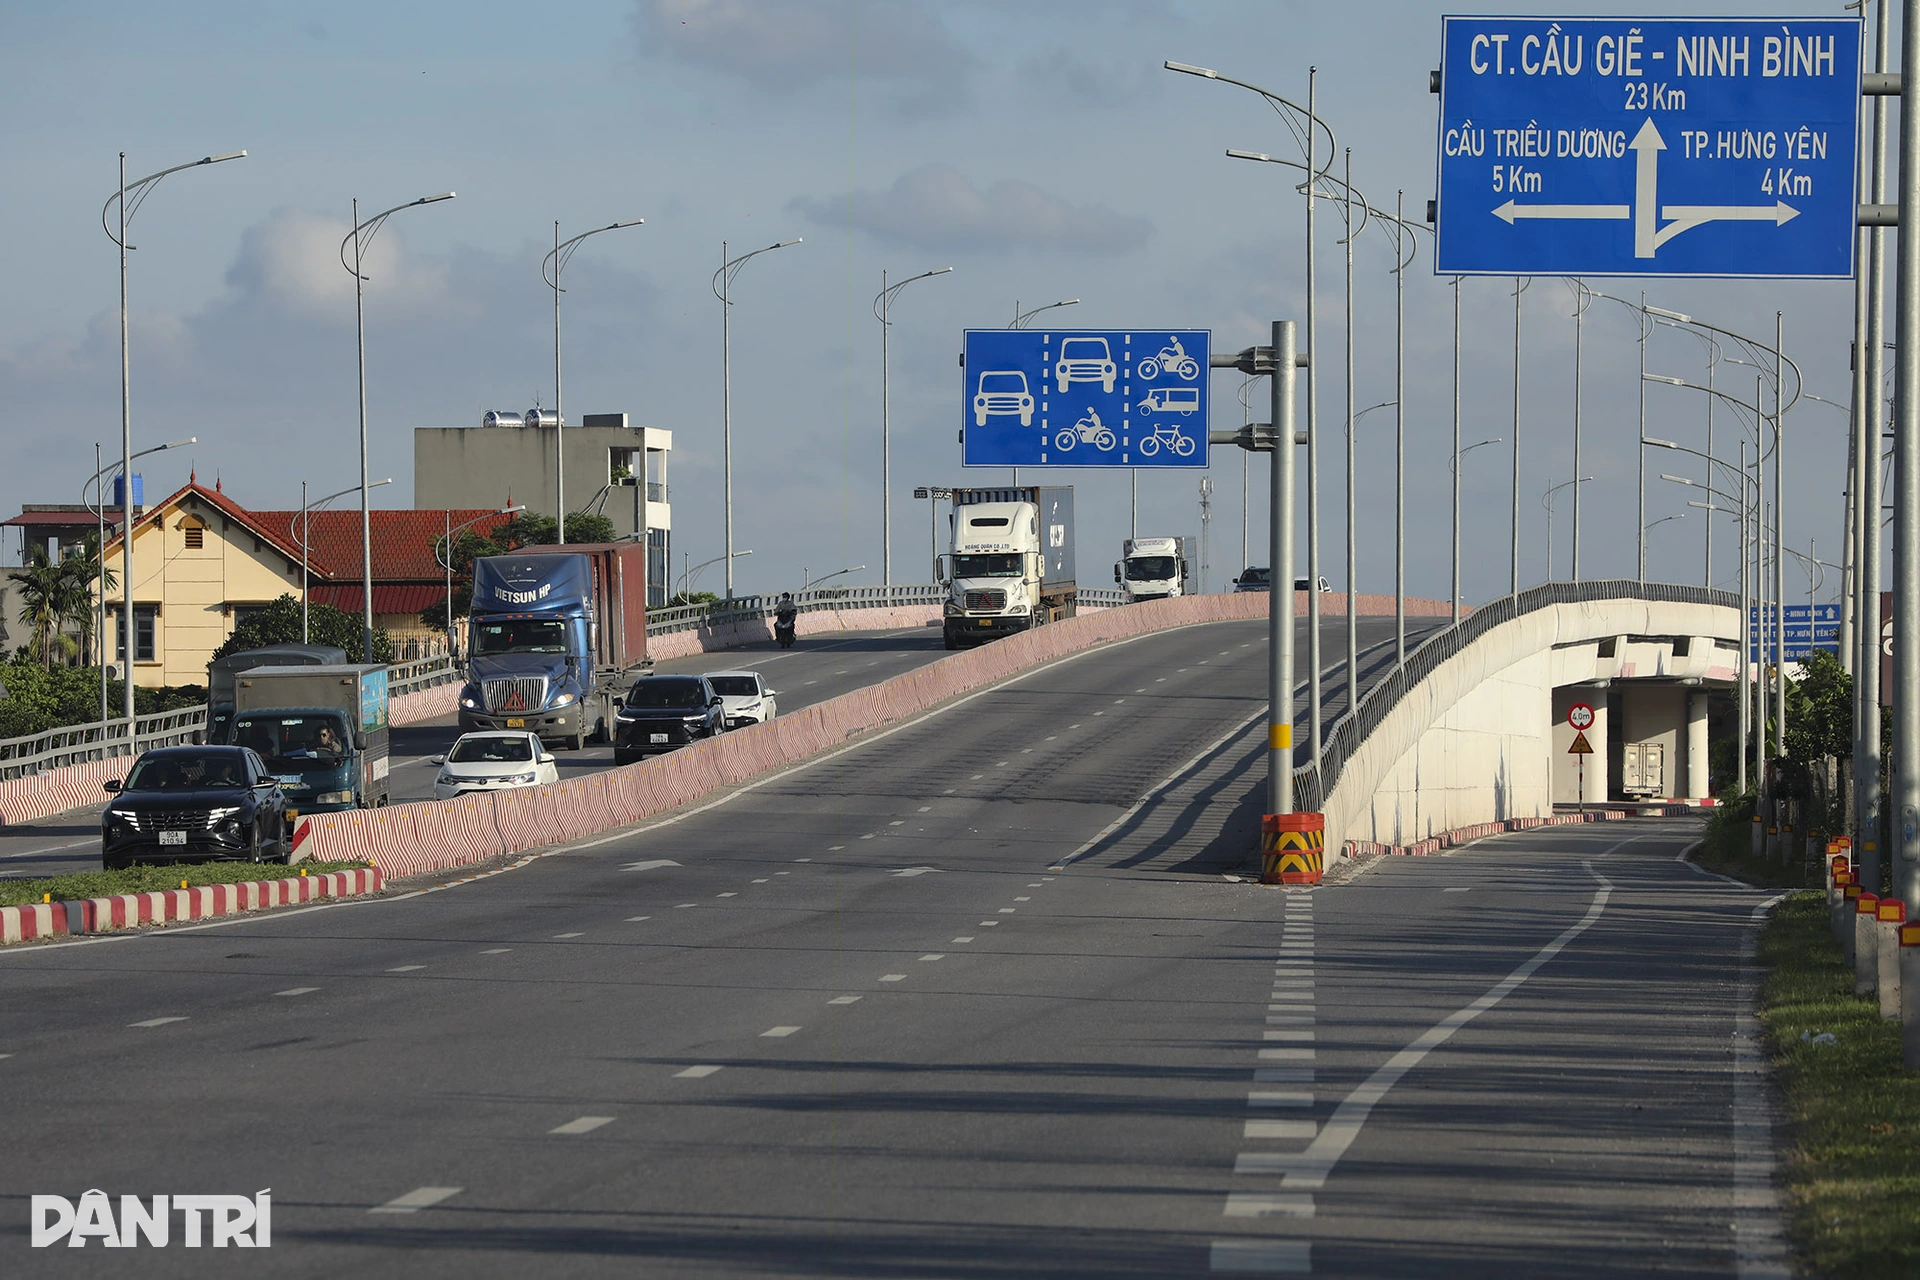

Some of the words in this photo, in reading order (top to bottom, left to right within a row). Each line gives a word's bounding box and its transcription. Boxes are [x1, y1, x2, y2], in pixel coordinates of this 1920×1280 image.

[1471, 23, 1583, 75] CT.CẦU
[1596, 28, 1643, 76] GIẼ
[1677, 36, 1749, 76] NINH
[1762, 26, 1834, 76] BÌNH
[1624, 83, 1648, 110] 23
[1653, 83, 1686, 110] Km
[1445, 120, 1484, 157] CẦU
[1493, 120, 1550, 157] TRIỀU
[1557, 129, 1626, 159] DƯƠNG
[1681, 129, 1776, 159] TP.HƯNG
[1784, 126, 1827, 159] YÊN
[1493, 166, 1504, 192] 5
[1509, 166, 1542, 193] Km
[1761, 168, 1773, 195] 4
[1778, 168, 1812, 196] Km
[494, 585, 537, 604] VIETSUN
[538, 583, 551, 599] HP
